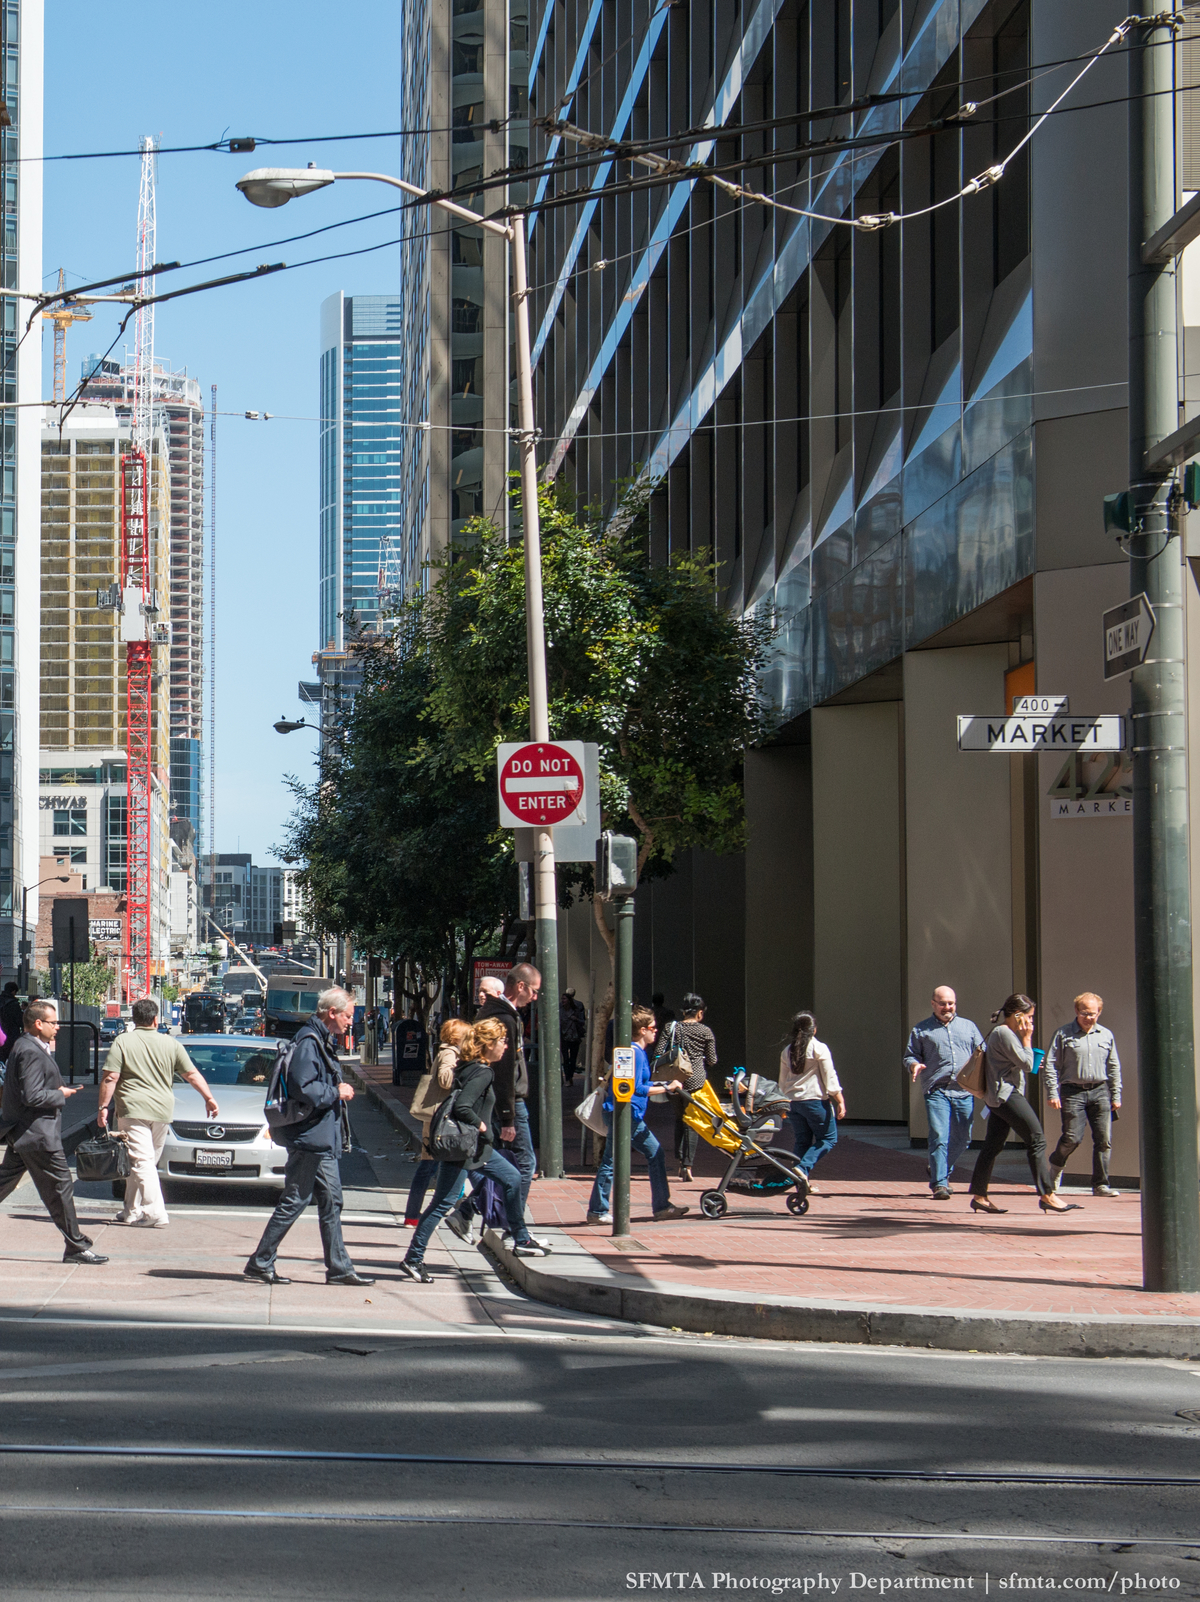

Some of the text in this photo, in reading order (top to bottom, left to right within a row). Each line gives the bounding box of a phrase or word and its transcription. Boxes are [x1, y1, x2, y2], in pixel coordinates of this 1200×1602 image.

[1108, 619, 1140, 656] ONE WAY
[1020, 698, 1050, 712] 400
[987, 723, 1103, 744] MARKET
[511, 758, 571, 774] DO NOT
[39, 795, 88, 810] CHWAB
[518, 796, 567, 810] ENTER
[1058, 800, 1132, 815] MARKE
[90, 920, 119, 928] MARINE
[91, 927, 121, 935] LECTRIC
[474, 968, 485, 978] NO
